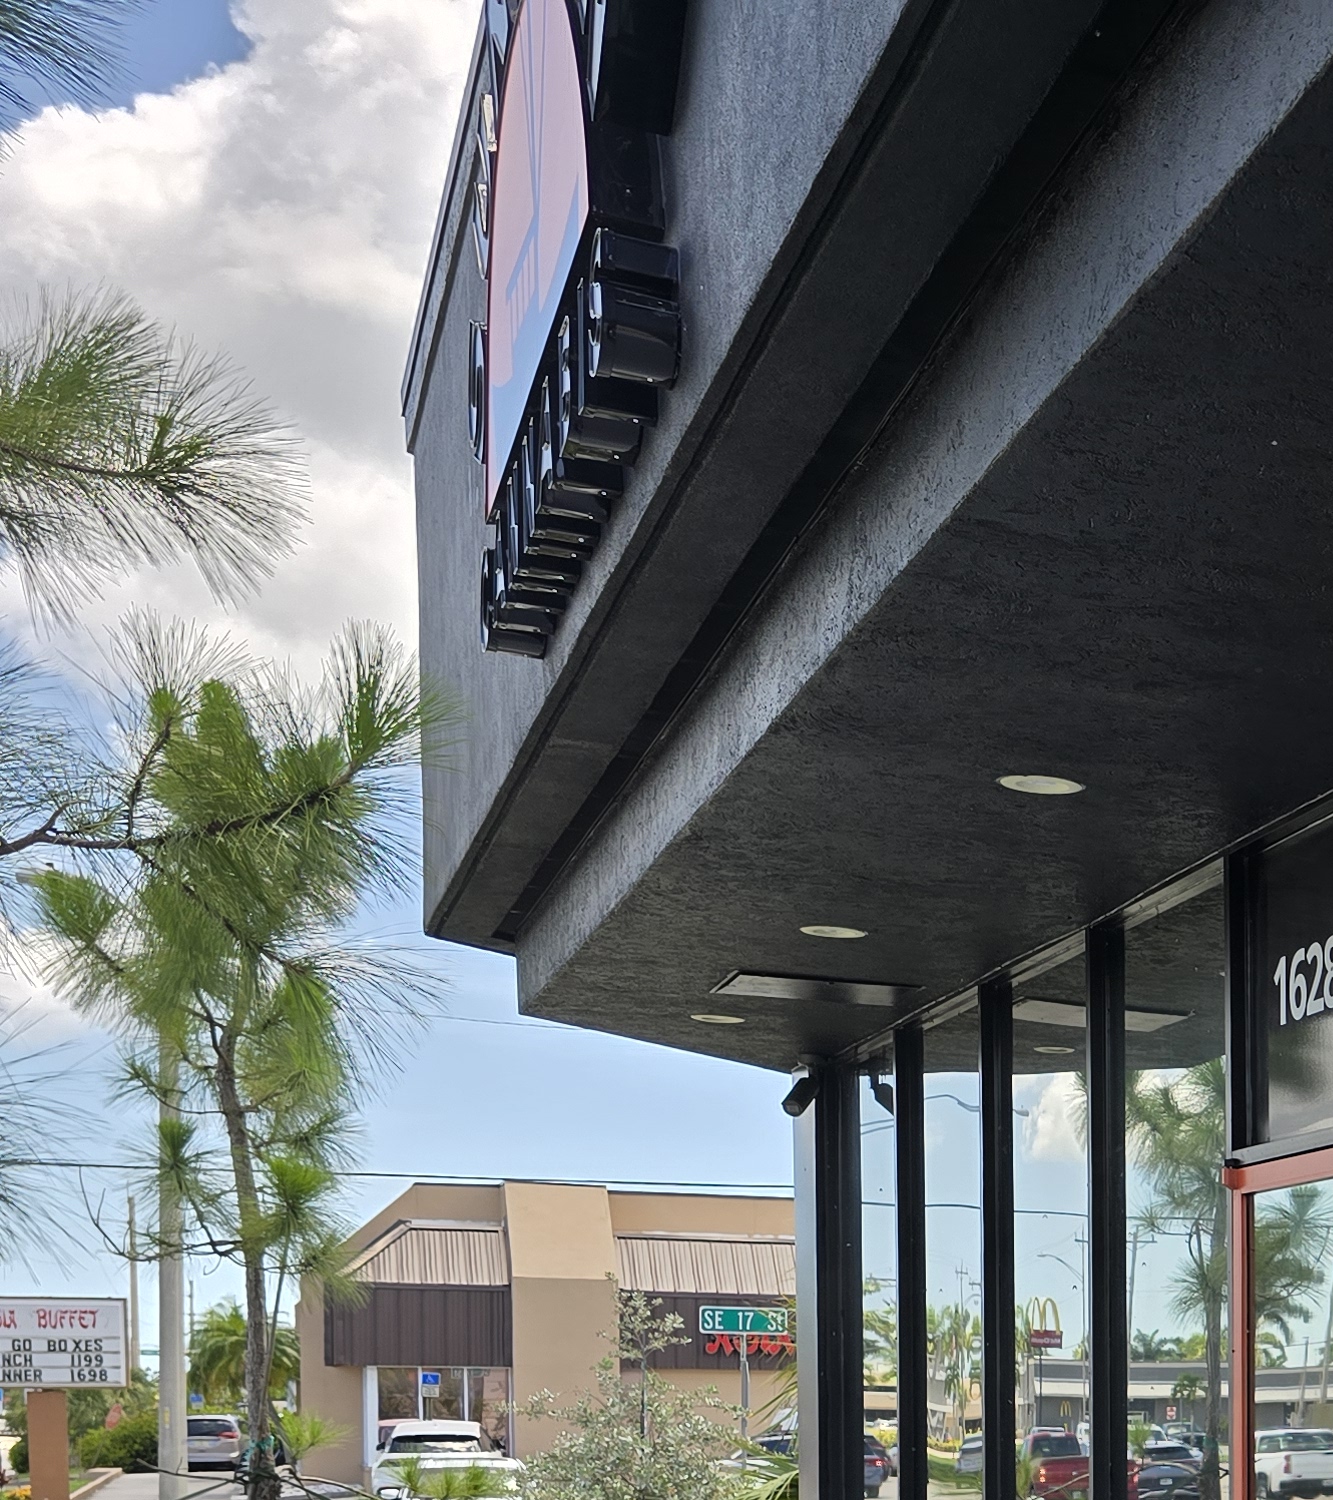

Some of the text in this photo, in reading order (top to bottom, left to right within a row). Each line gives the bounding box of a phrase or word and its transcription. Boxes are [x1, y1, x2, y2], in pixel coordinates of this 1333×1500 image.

[36, 1308, 98, 1330] BUFFET
[703, 1310, 724, 1330] SE
[737, 1311, 755, 1330] 17
[12, 1339, 32, 1352] GO
[70, 1354, 104, 1368] 1199
[70, 1369, 108, 1382] 1698
